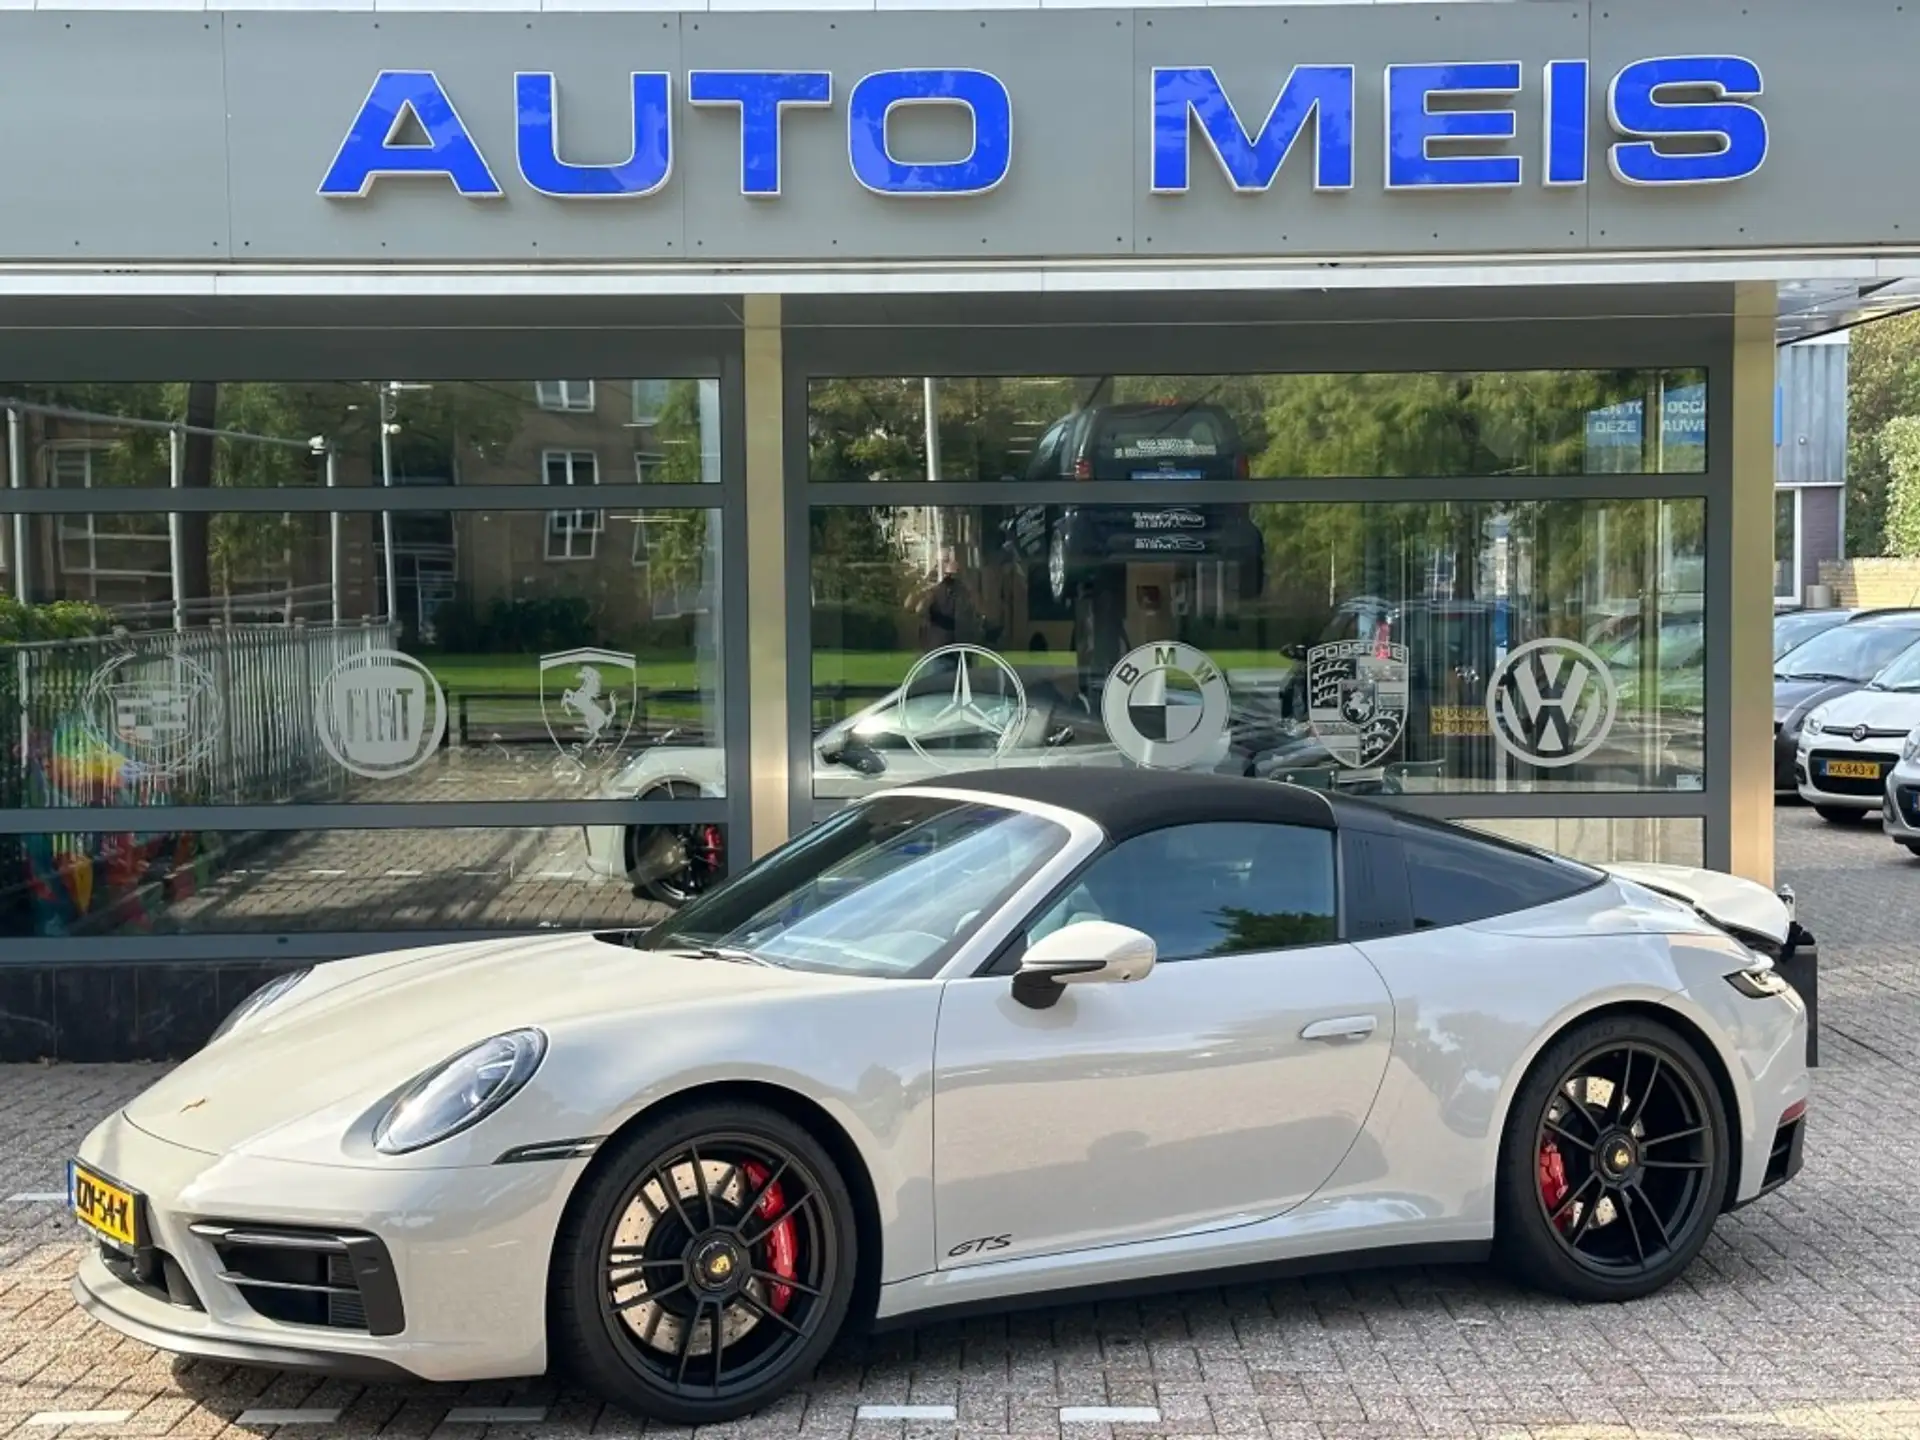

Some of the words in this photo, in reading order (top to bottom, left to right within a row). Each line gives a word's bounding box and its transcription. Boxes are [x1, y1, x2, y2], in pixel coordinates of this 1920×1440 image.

[315, 67, 1013, 198] AUTO
[1149, 54, 1769, 193] MEIS
[1595, 419, 1637, 433] DEZE
[1116, 646, 1217, 687] BMW
[346, 687, 414, 743] FIAT
[948, 1233, 1012, 1257] GTS
